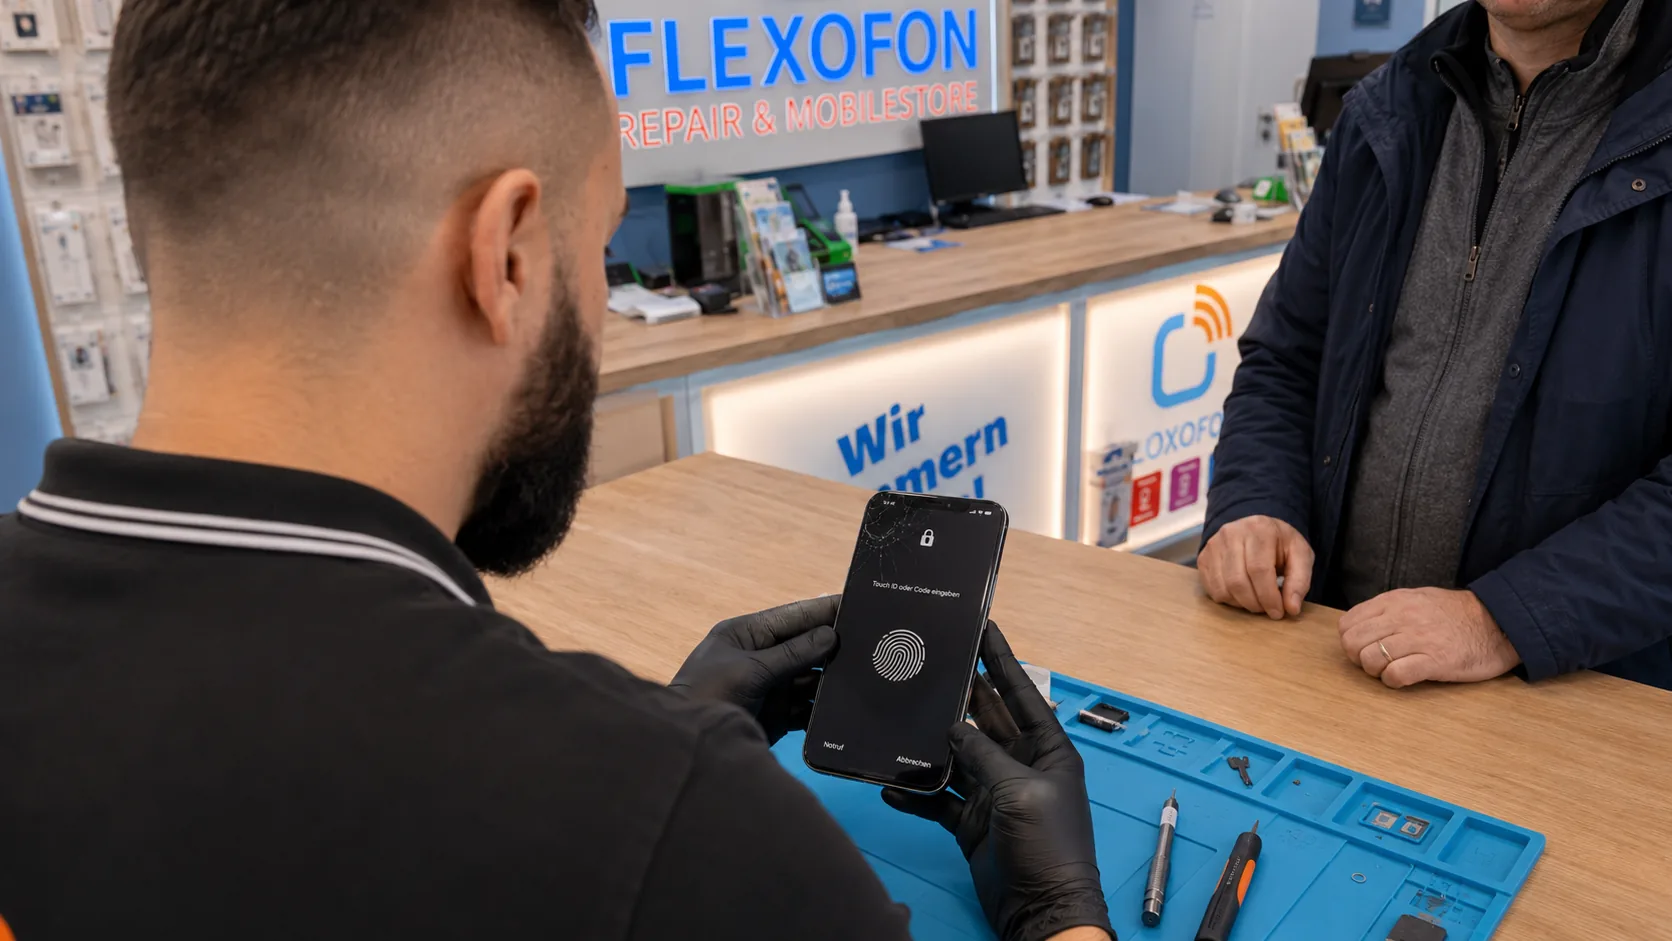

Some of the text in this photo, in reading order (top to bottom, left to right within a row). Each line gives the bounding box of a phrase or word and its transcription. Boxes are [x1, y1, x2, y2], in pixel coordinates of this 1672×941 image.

[608, 8, 978, 98] FLEXOFON
[619, 80, 978, 149] REPAIR & MOBILESTORE
[837, 402, 925, 477] Wir
[878, 415, 1008, 493] mern
[1132, 411, 1224, 464] OXOFO
[914, 586, 930, 594] Code
[824, 741, 844, 751] Notruf
[896, 756, 931, 768] Abbrechen
